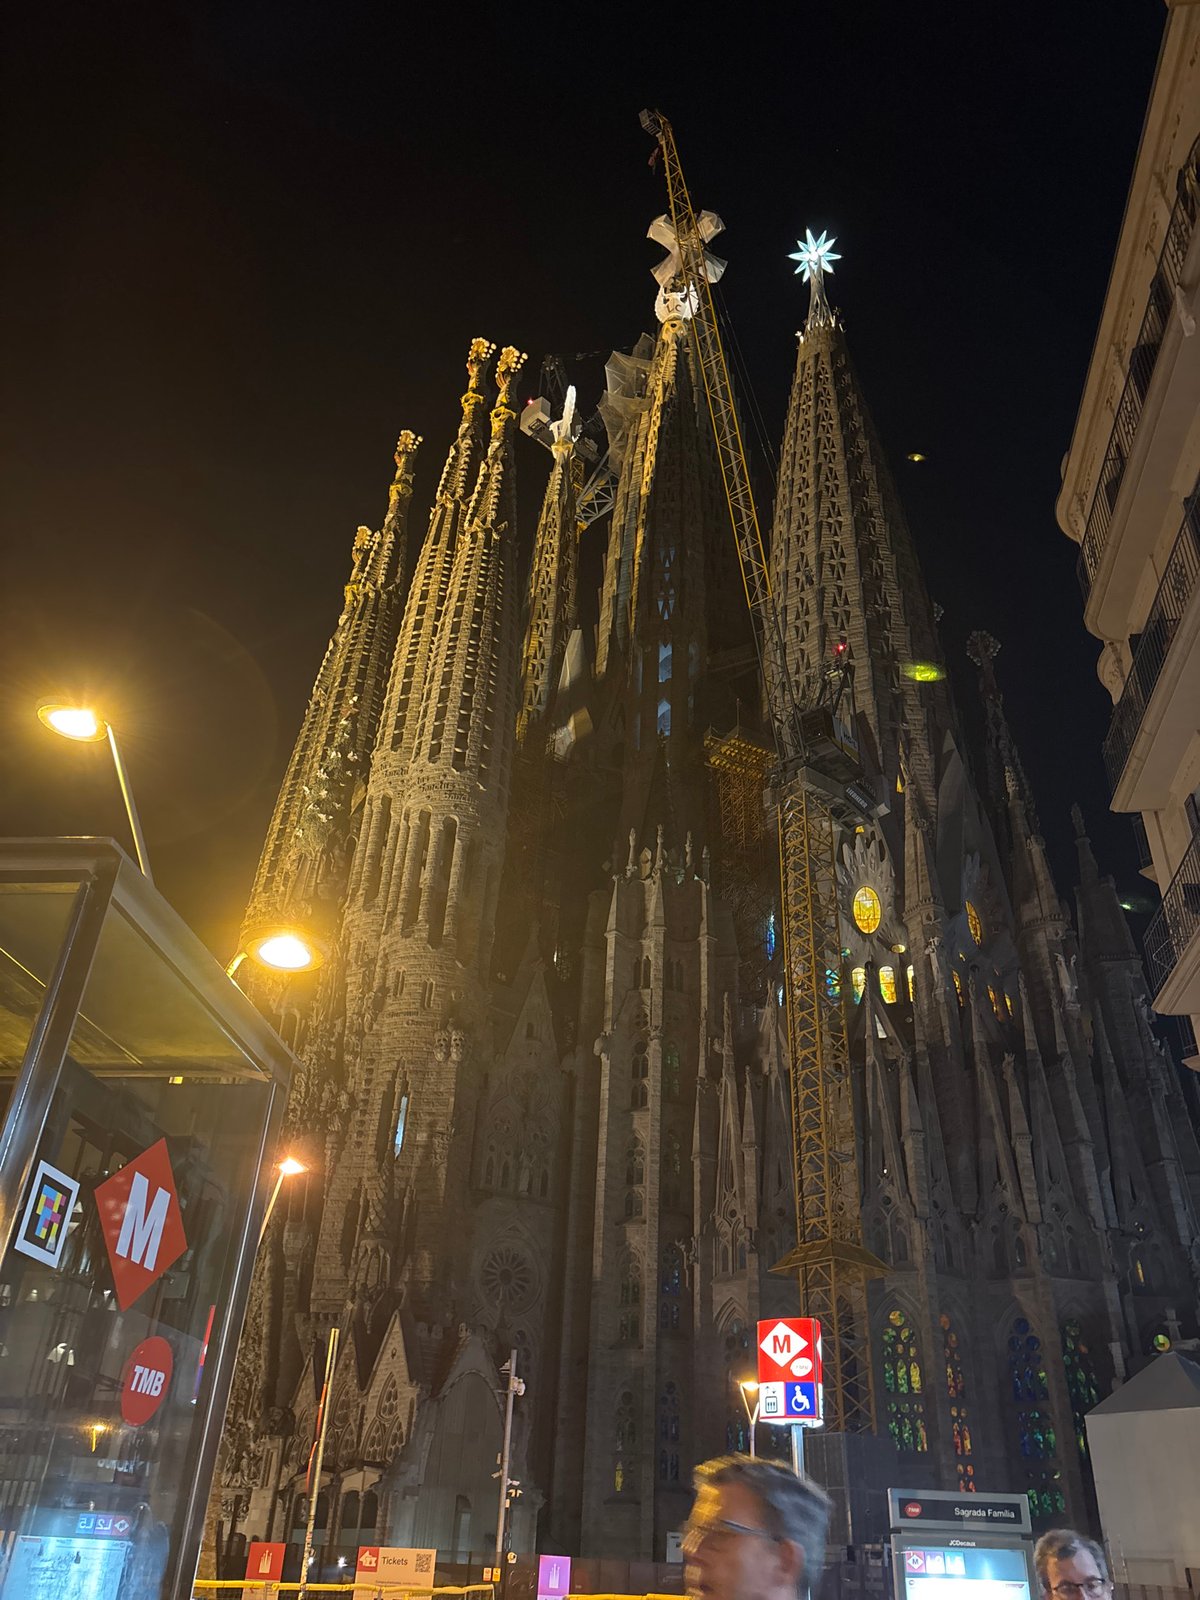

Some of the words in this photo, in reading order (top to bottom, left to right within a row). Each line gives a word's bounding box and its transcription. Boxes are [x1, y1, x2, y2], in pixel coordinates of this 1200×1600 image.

[115, 1171, 171, 1272] M
[772, 1334, 791, 1354] M
[130, 1364, 165, 1397] TMB
[954, 1507, 986, 1518] Sagrada
[382, 1556, 408, 1566] Tickets
[912, 1558, 919, 1566] M
